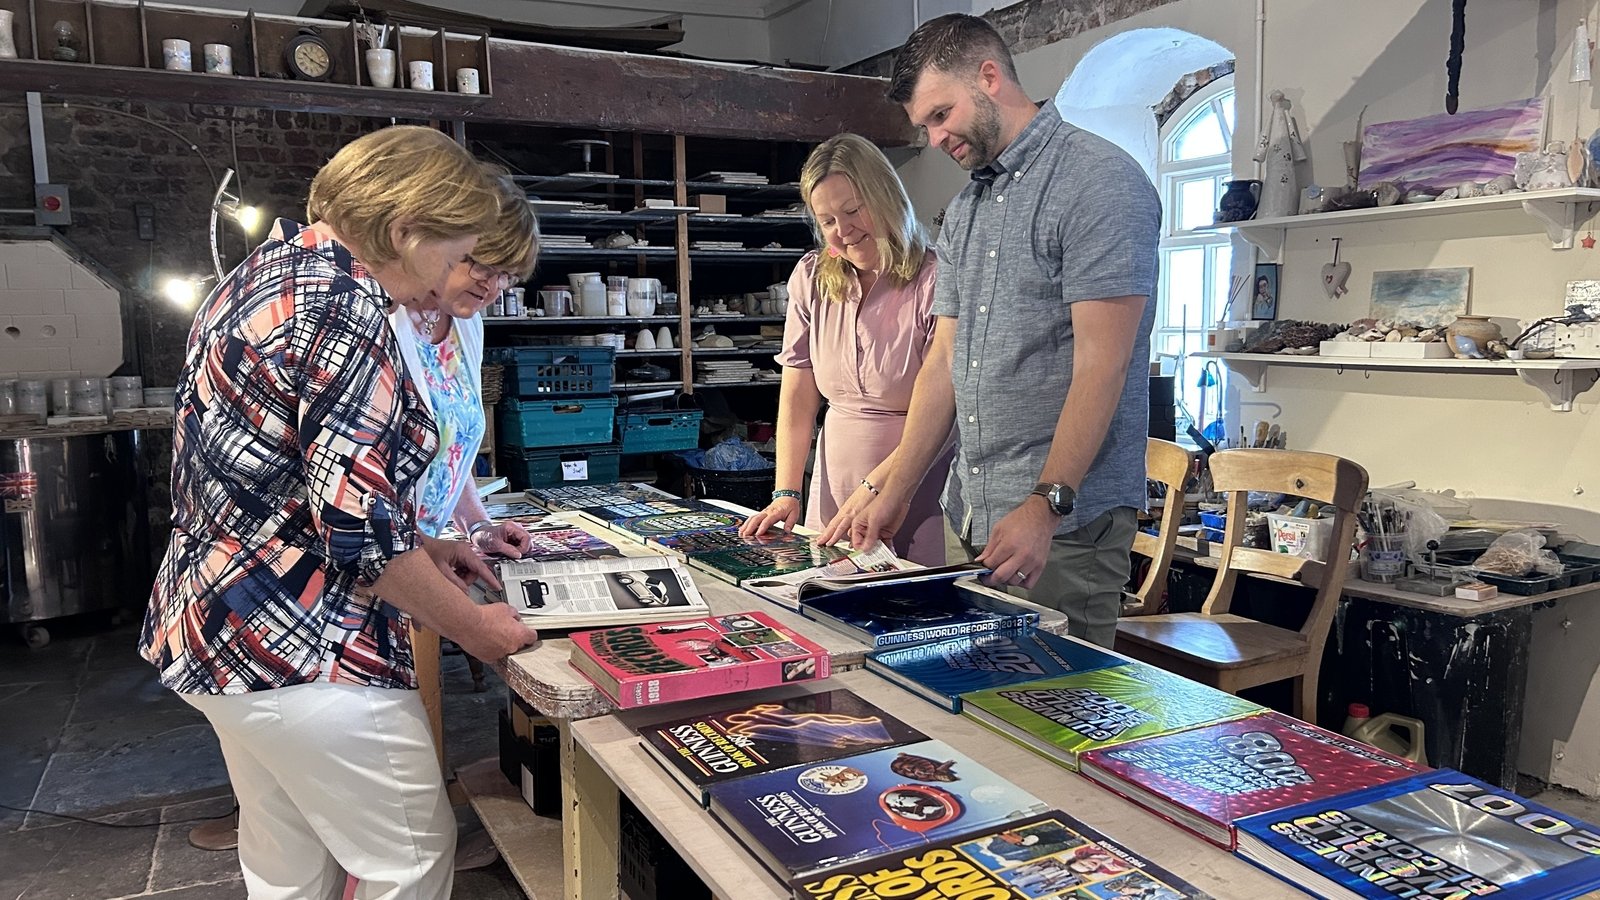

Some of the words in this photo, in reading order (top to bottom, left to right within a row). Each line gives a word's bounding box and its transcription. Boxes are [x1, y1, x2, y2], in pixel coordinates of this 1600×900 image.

[1277, 529, 1296, 541] Persil
[877, 630, 924, 646] GUINNESS
[926, 626, 958, 640] WORLD
[960, 621, 999, 635] RECORDS
[1001, 618, 1023, 629] 2012
[605, 627, 694, 674] RECORDS
[648, 679, 660, 703] 1988
[1066, 688, 1157, 722] 2009
[1004, 690, 1112, 741] GUINNESS
[1026, 690, 1128, 735] WORLD
[1050, 689, 1139, 728] RECORDS
[669, 724, 740, 773] GUINNESS
[692, 721, 730, 746] RECORDS
[676, 746, 693, 758] THE
[729, 750, 758, 768] BOOK
[1216, 731, 1315, 787] 2008
[756, 794, 822, 843] GUINNESS
[776, 791, 812, 817] RECORDS
[1428, 783, 1600, 856] 2007
[810, 821, 838, 839] BOOK
[1097, 840, 1129, 858] EDITION
[1270, 820, 1422, 900] UINNESS
[1322, 809, 1502, 897] RECORDS
[860, 868, 926, 897] OF
